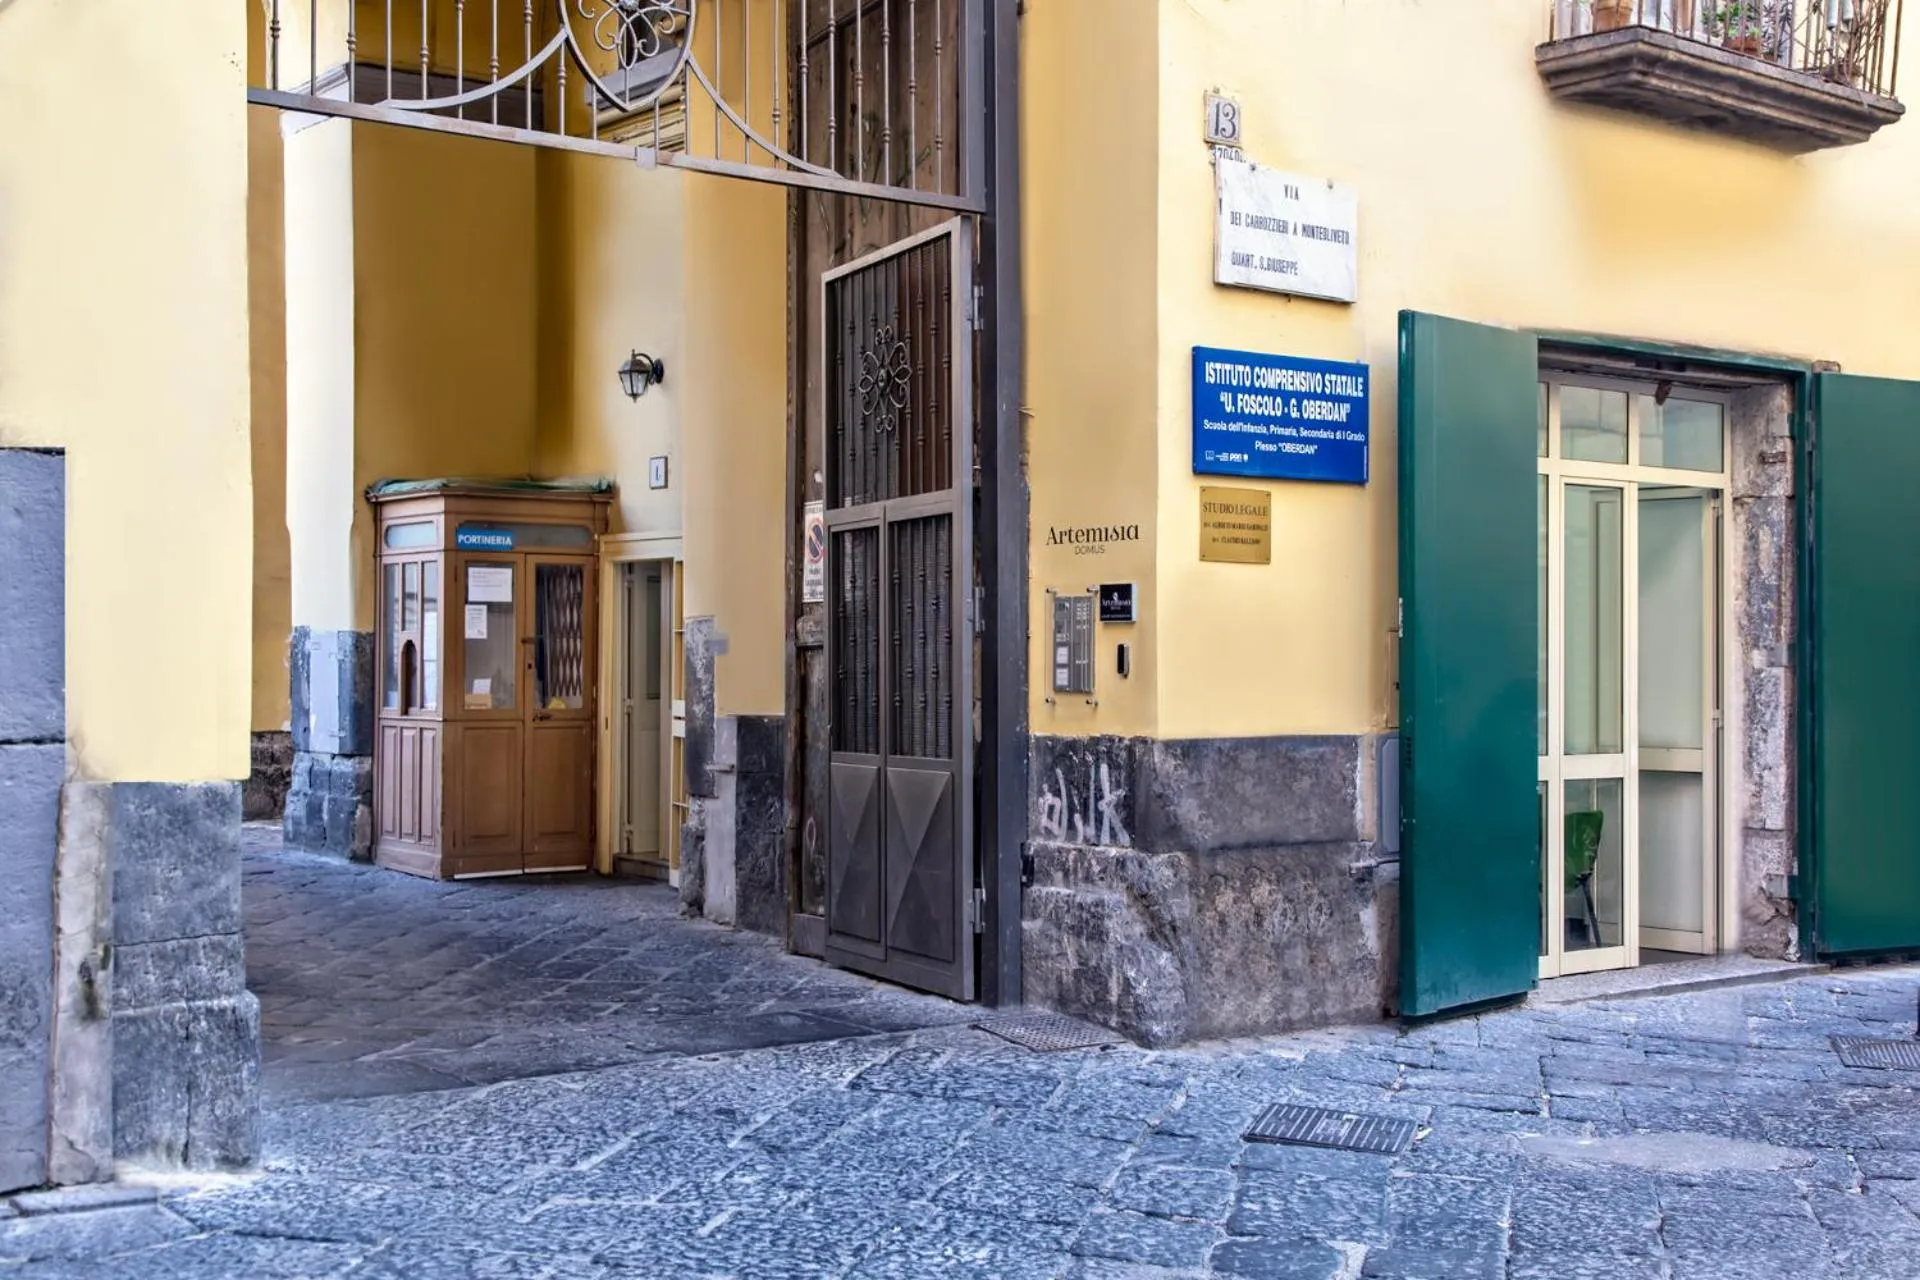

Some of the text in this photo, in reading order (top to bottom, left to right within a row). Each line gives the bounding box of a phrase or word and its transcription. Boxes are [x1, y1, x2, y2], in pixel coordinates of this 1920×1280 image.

[1214, 102, 1236, 138] 13
[1284, 184, 1299, 201] VIA
[1230, 210, 1349, 245] DEI CARROZZIERI A MONTEOLIVETO
[1231, 251, 1257, 270] QUART.
[1205, 361, 1364, 398] ISTITUTO COMPRENSIVO STATALE
[1237, 392, 1282, 417] FOSCOLO
[1289, 397, 1300, 418] G.
[1203, 418, 1227, 431] Scuola
[1269, 424, 1299, 438] Primaria,
[1300, 426, 1334, 440] Secondaria
[1335, 430, 1342, 440] di
[1346, 430, 1366, 442] Grado
[1255, 440, 1277, 452] Plesso
[1202, 501, 1267, 517] STUDIO LEGALE
[458, 534, 513, 546] PORTINERIA
[1045, 524, 1140, 546] Artemisia
[1074, 544, 1105, 555] DOMUS
